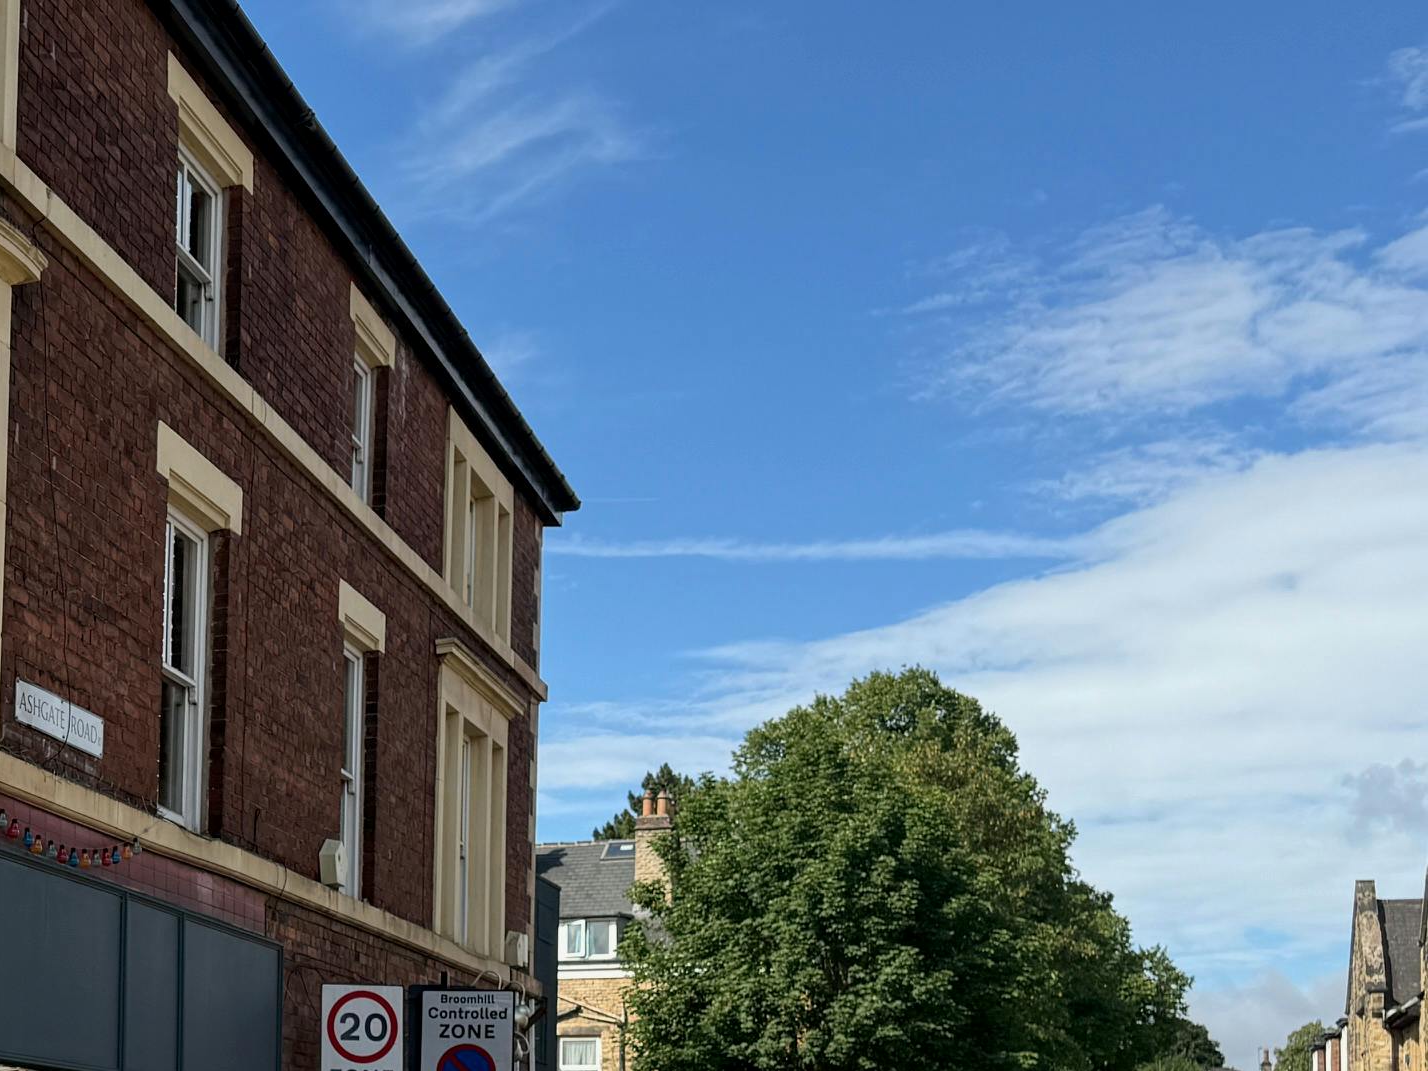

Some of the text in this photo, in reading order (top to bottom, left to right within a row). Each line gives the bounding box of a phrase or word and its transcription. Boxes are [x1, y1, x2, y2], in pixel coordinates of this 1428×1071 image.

[19, 692, 98, 744] ASHGATE ROAD
[440, 993, 496, 1005] Broomhill
[428, 1006, 508, 1020] Controlled
[339, 1012, 388, 1042] 20
[439, 1023, 496, 1039] ZONE
